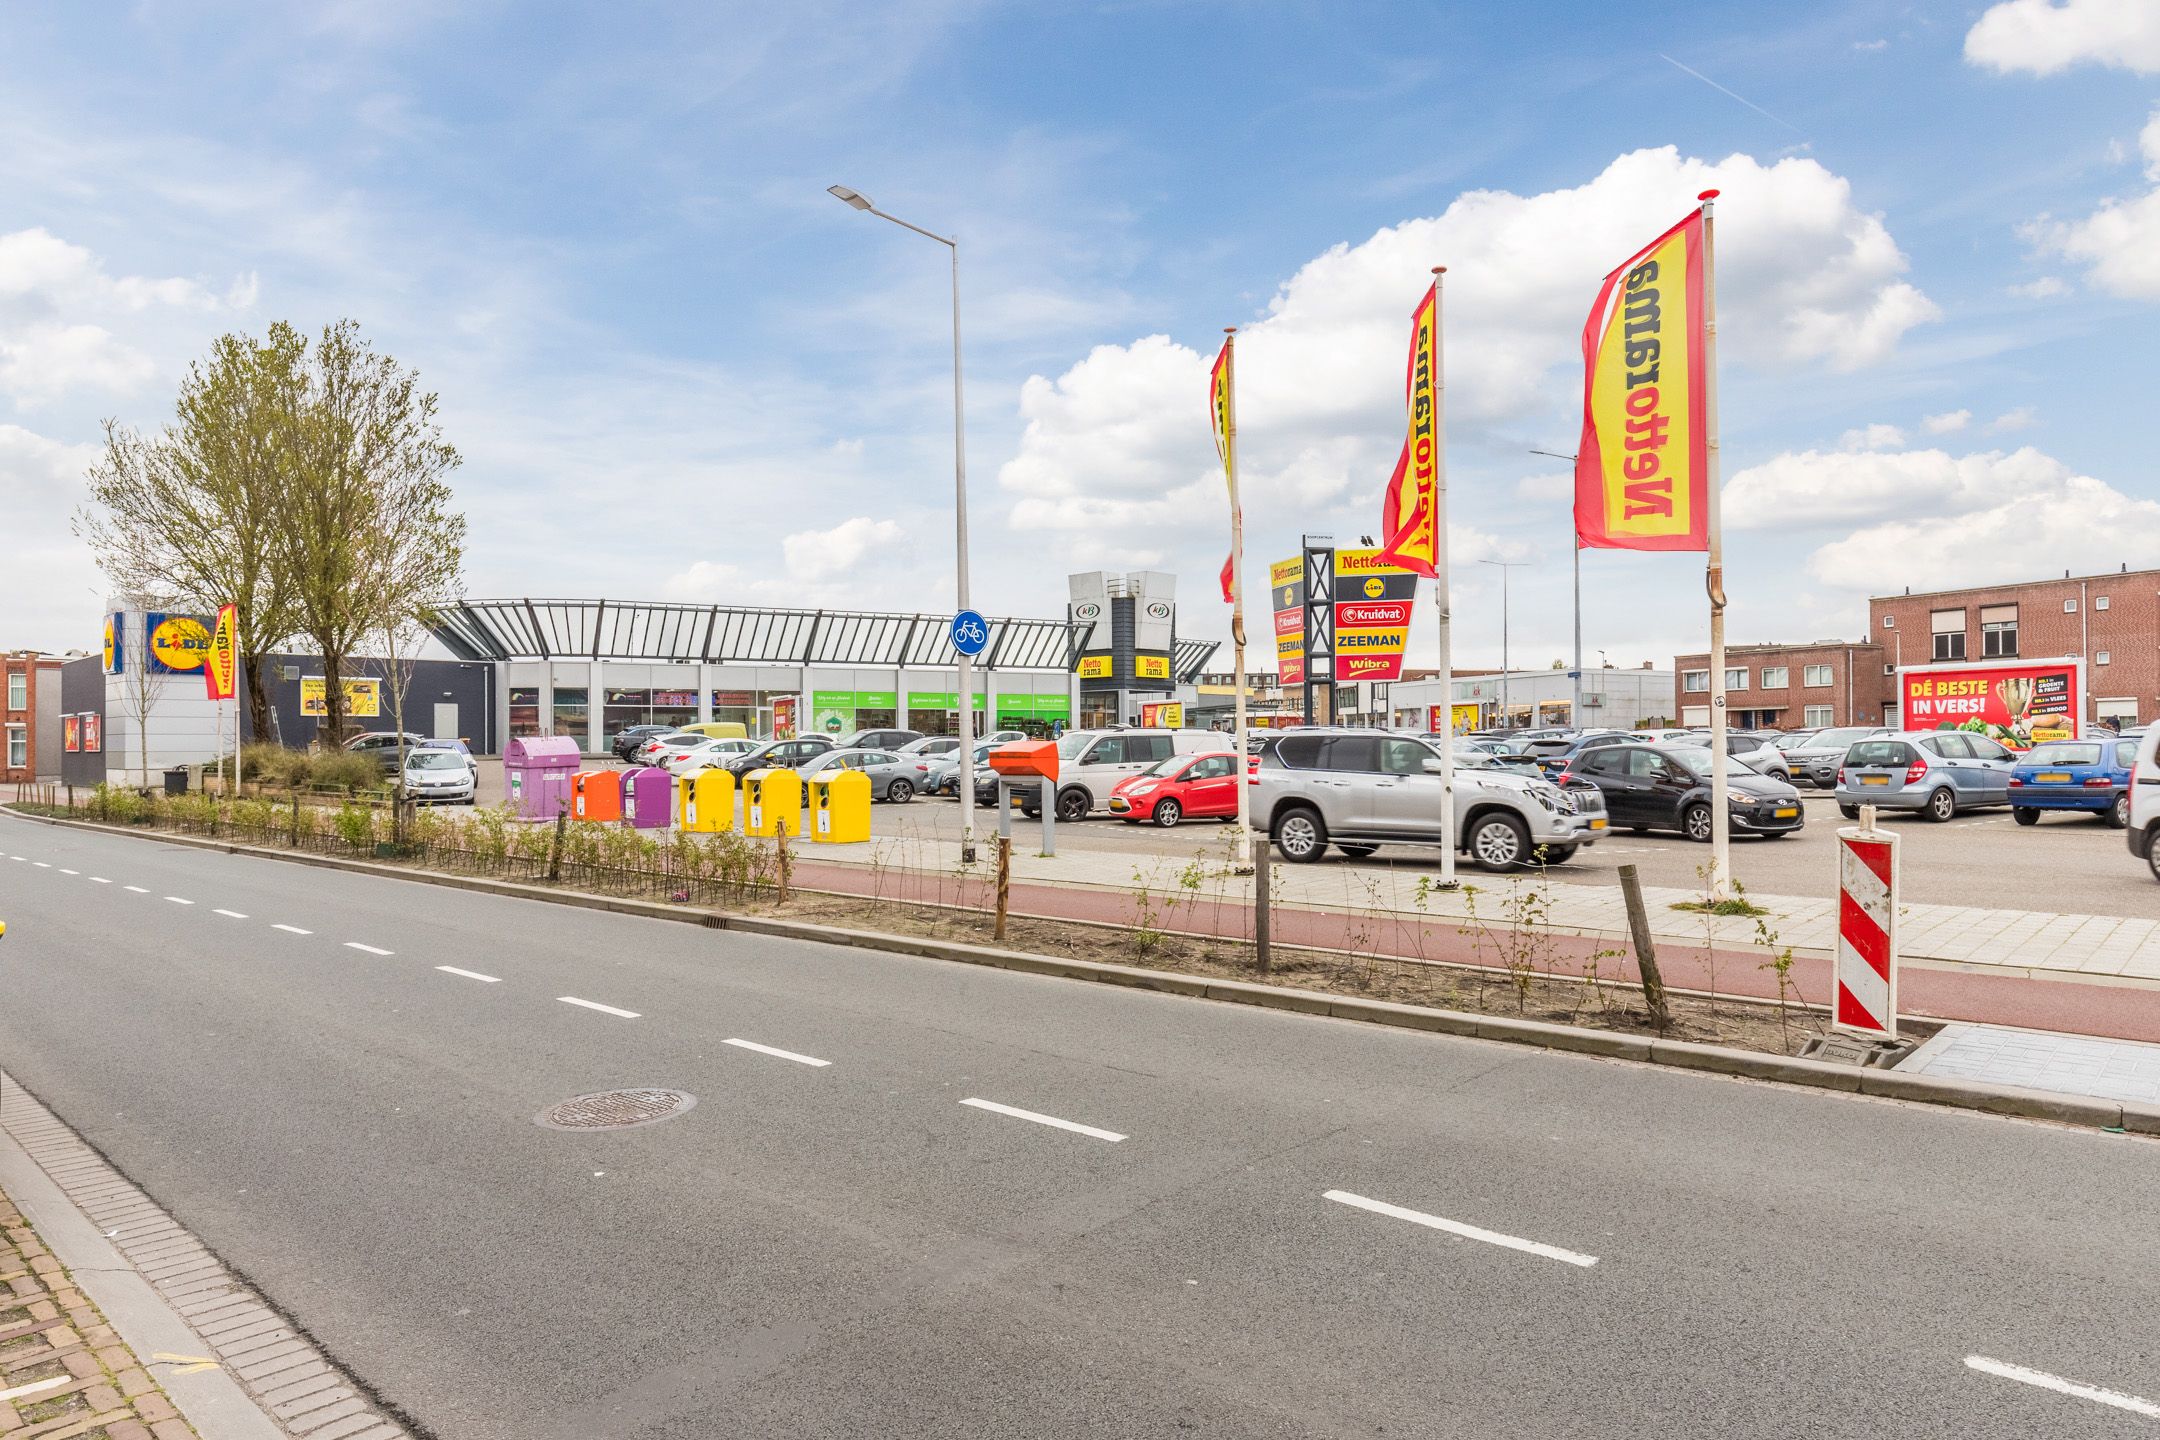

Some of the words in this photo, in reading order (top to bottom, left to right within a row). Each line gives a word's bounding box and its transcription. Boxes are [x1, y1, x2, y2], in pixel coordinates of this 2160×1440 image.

[1274, 565, 1302, 581] Nettorama
[1357, 609, 1401, 620] Kruidvat
[1278, 639, 1304, 653] ZEEMAN
[1337, 635, 1401, 647] ZEEMAN
[1084, 660, 1101, 668] Netto
[1146, 659, 1162, 668] Netto
[1283, 662, 1301, 673] Wibra
[1349, 657, 1390, 669] Wibra
[1084, 668, 1101, 676] rama
[1146, 668, 1162, 676] rama
[1911, 679, 1934, 697] DÉ
[1936, 680, 1989, 696] BESTE
[1912, 700, 1931, 715] IN
[1934, 697, 1986, 714] VERS!
